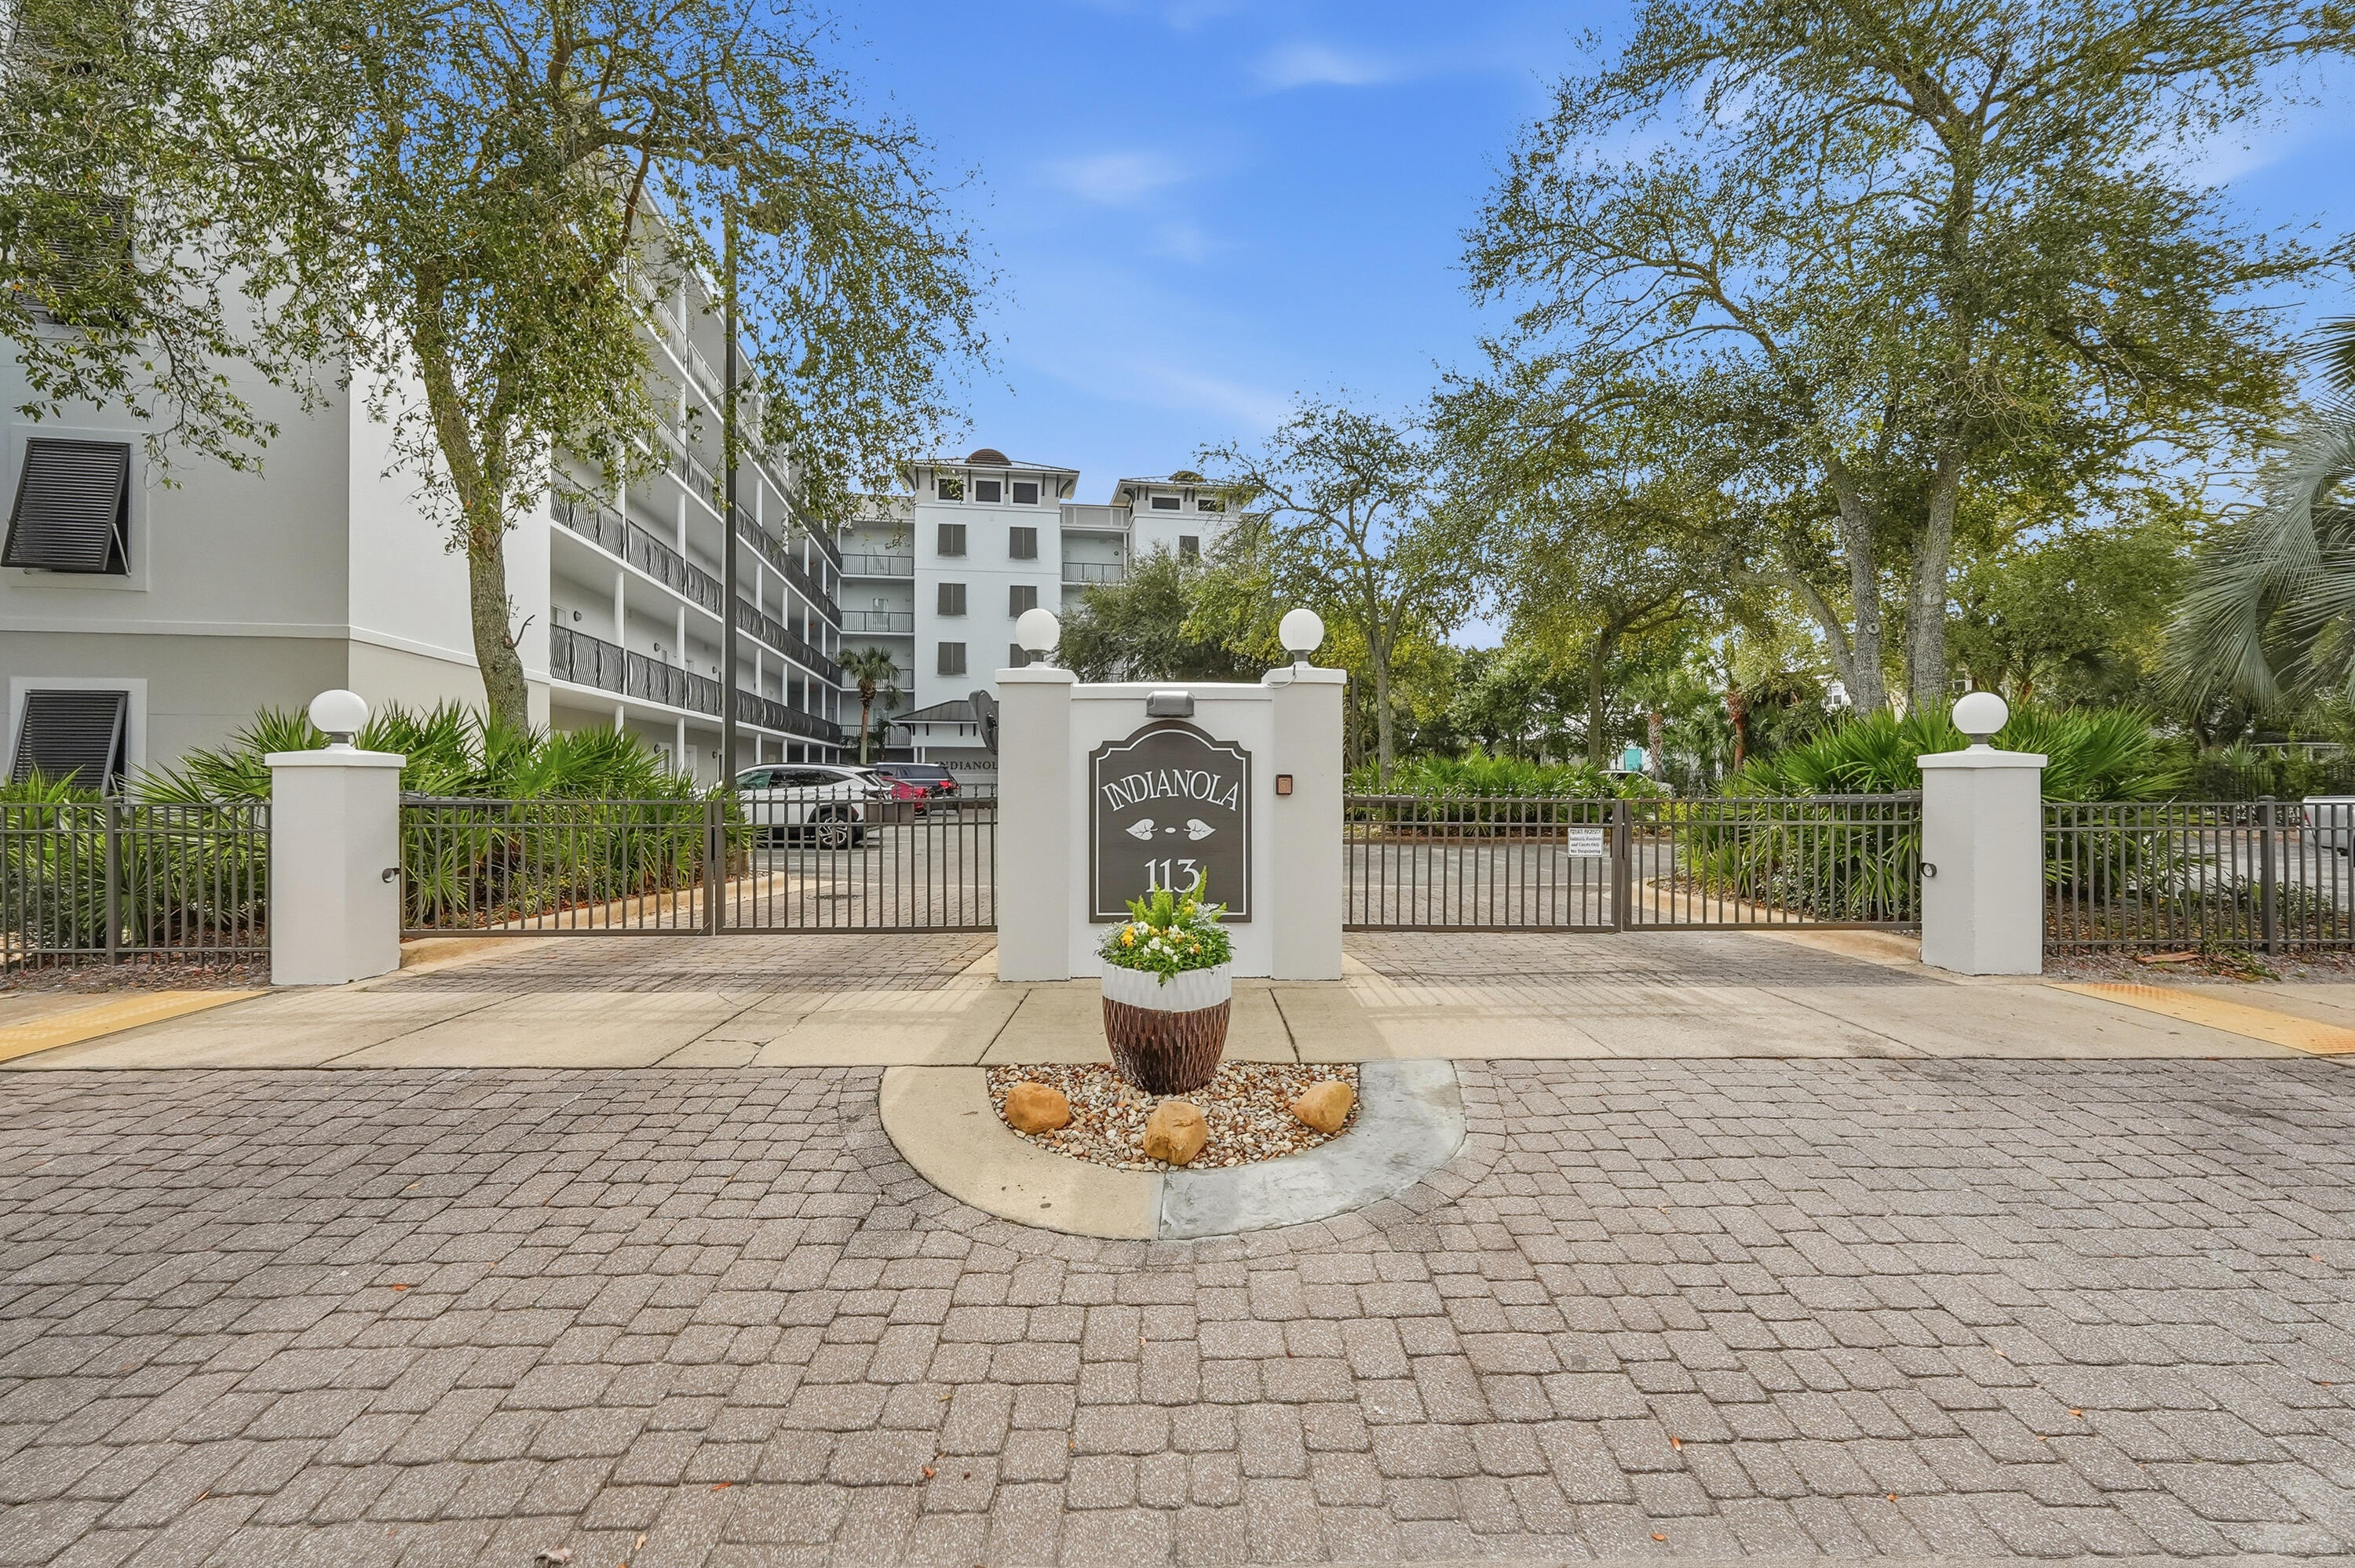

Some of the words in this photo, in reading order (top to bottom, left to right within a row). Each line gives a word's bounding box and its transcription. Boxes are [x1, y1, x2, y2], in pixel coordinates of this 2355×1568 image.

[935, 760, 998, 770] NDIANOL
[1101, 769, 1239, 811] INDIANOLA
[1145, 859, 1201, 894] 113
